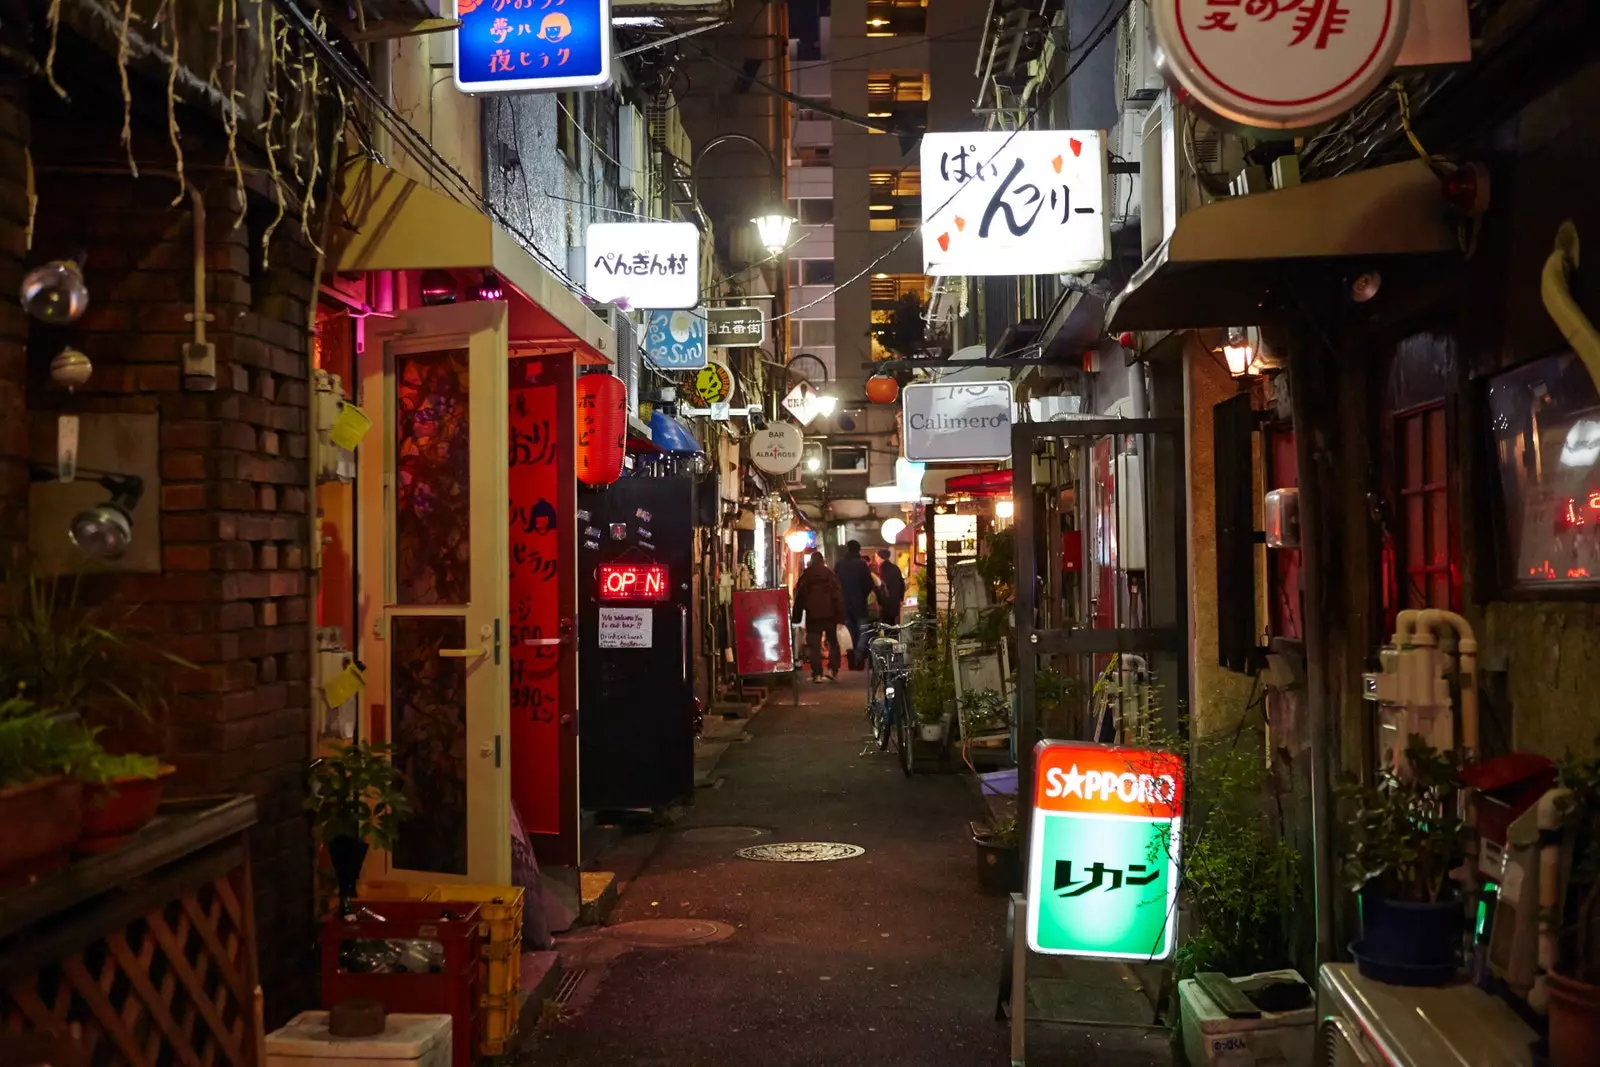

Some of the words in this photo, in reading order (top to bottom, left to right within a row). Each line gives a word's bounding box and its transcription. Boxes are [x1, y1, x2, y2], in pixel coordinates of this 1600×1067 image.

[488, 48, 571, 73] 夜ヒラク
[594, 250, 688, 275] ぺんぎん村
[910, 413, 1001, 431] Calimero
